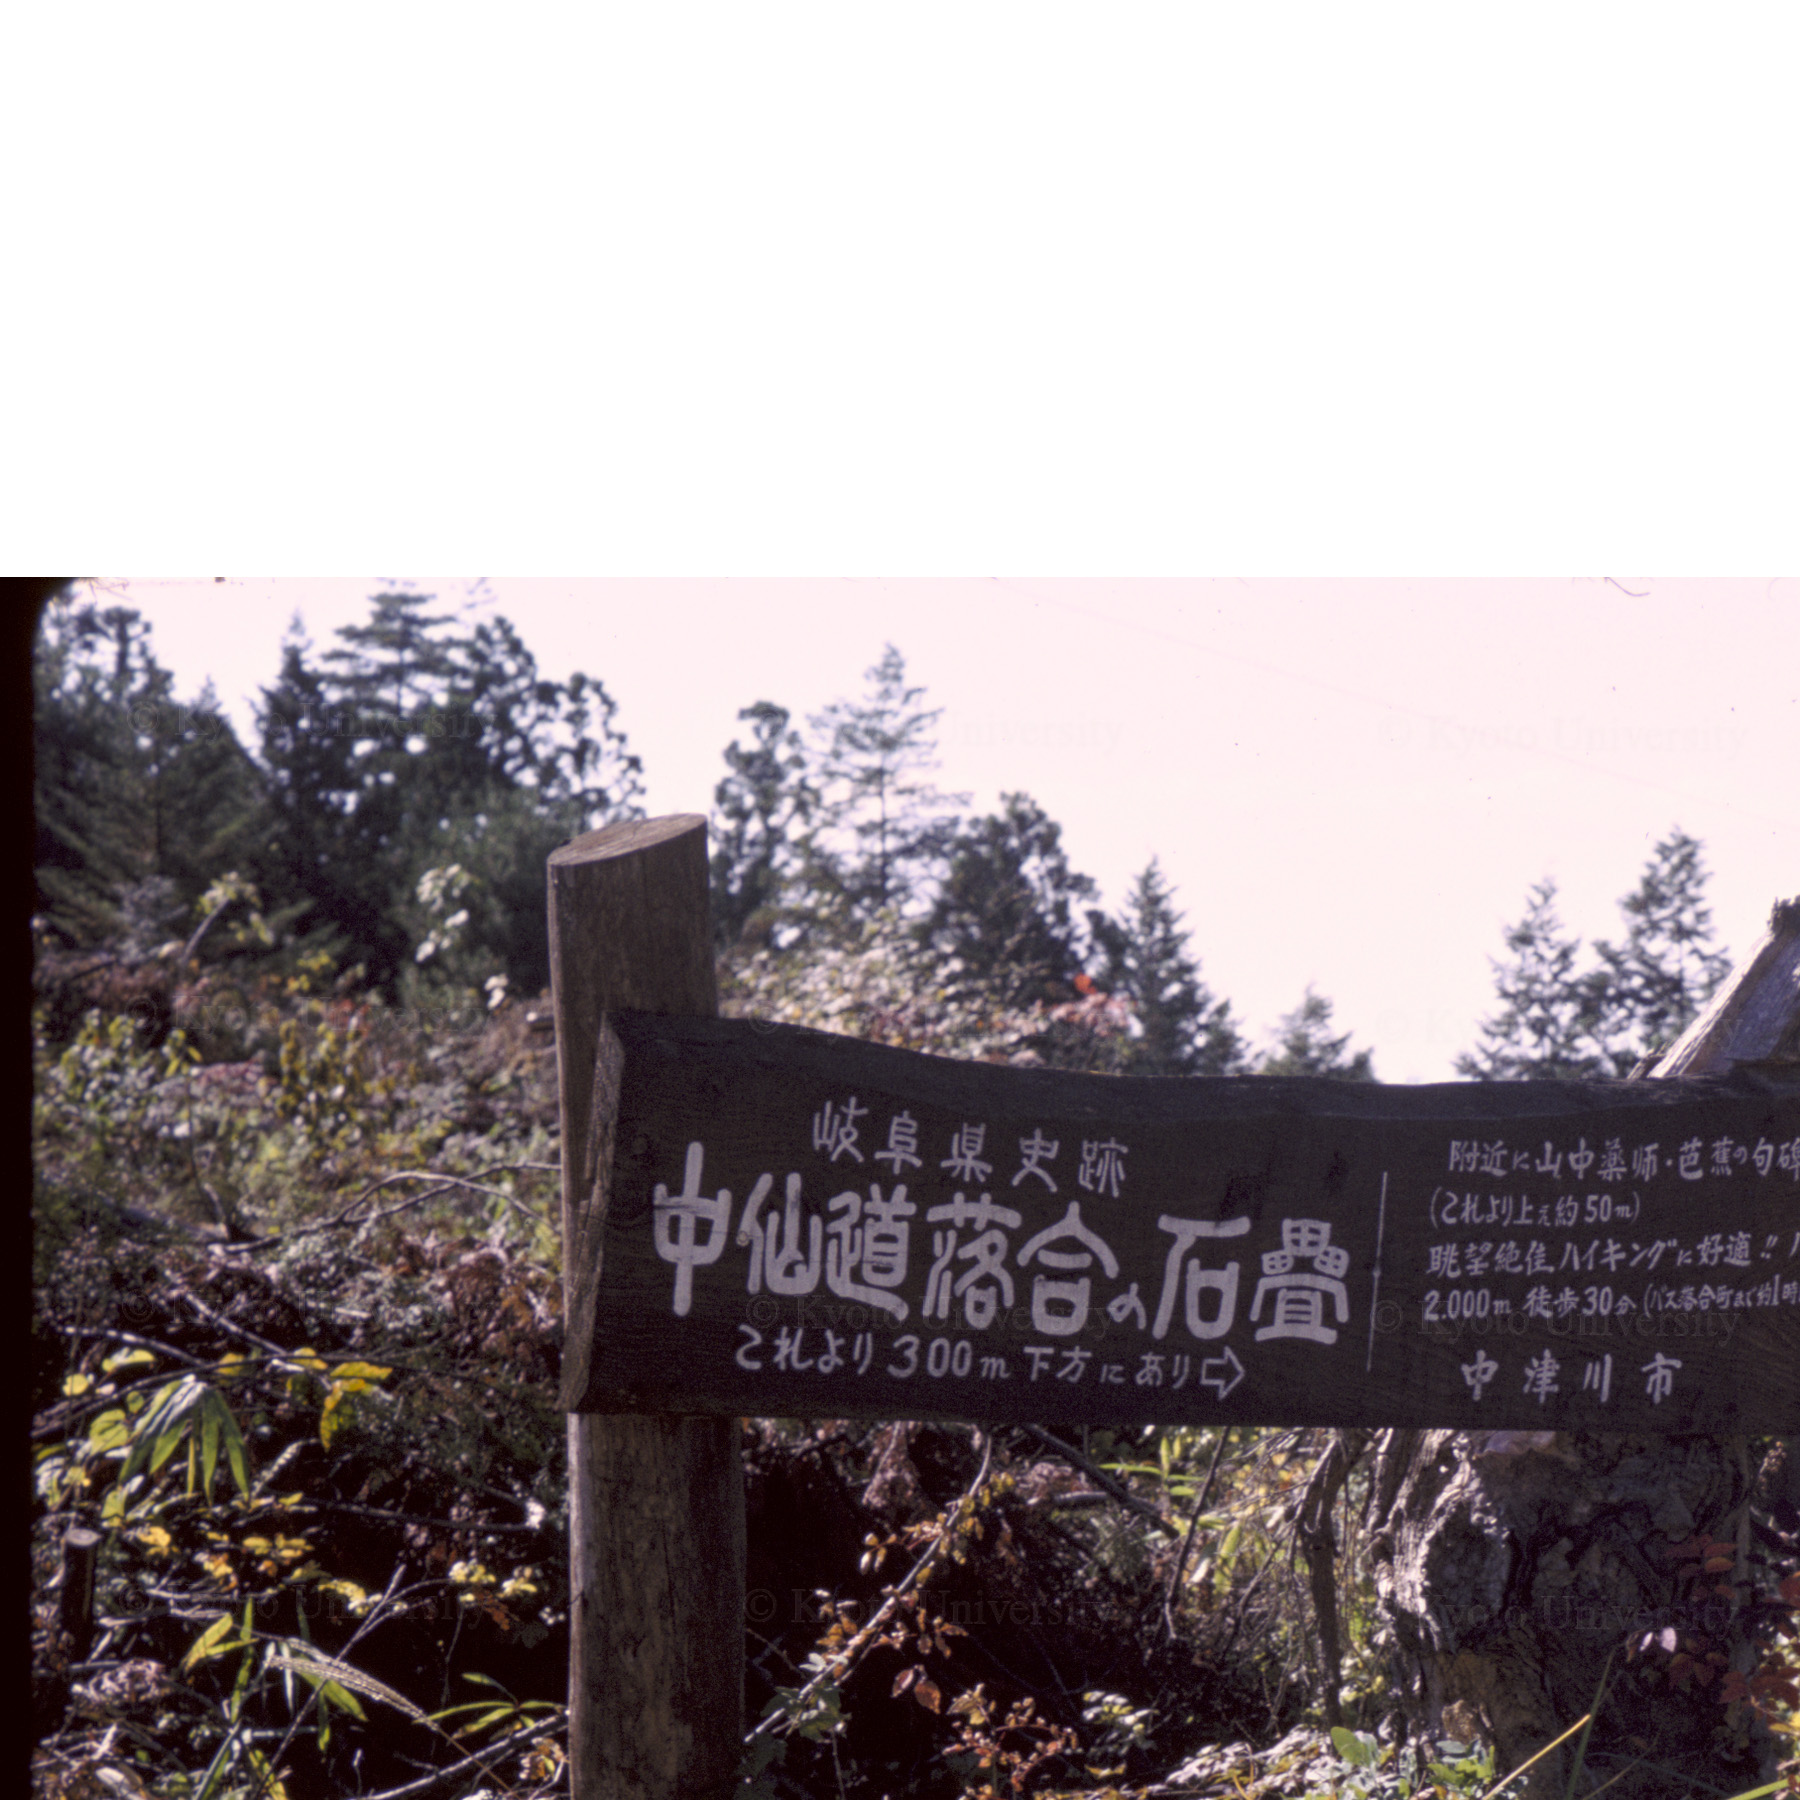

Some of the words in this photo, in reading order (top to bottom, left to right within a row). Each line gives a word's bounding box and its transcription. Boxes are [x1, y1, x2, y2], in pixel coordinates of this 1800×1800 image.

[811, 1096, 1129, 1198] 岐阜県史跡
[1461, 1349, 1683, 1404] 中津川市
